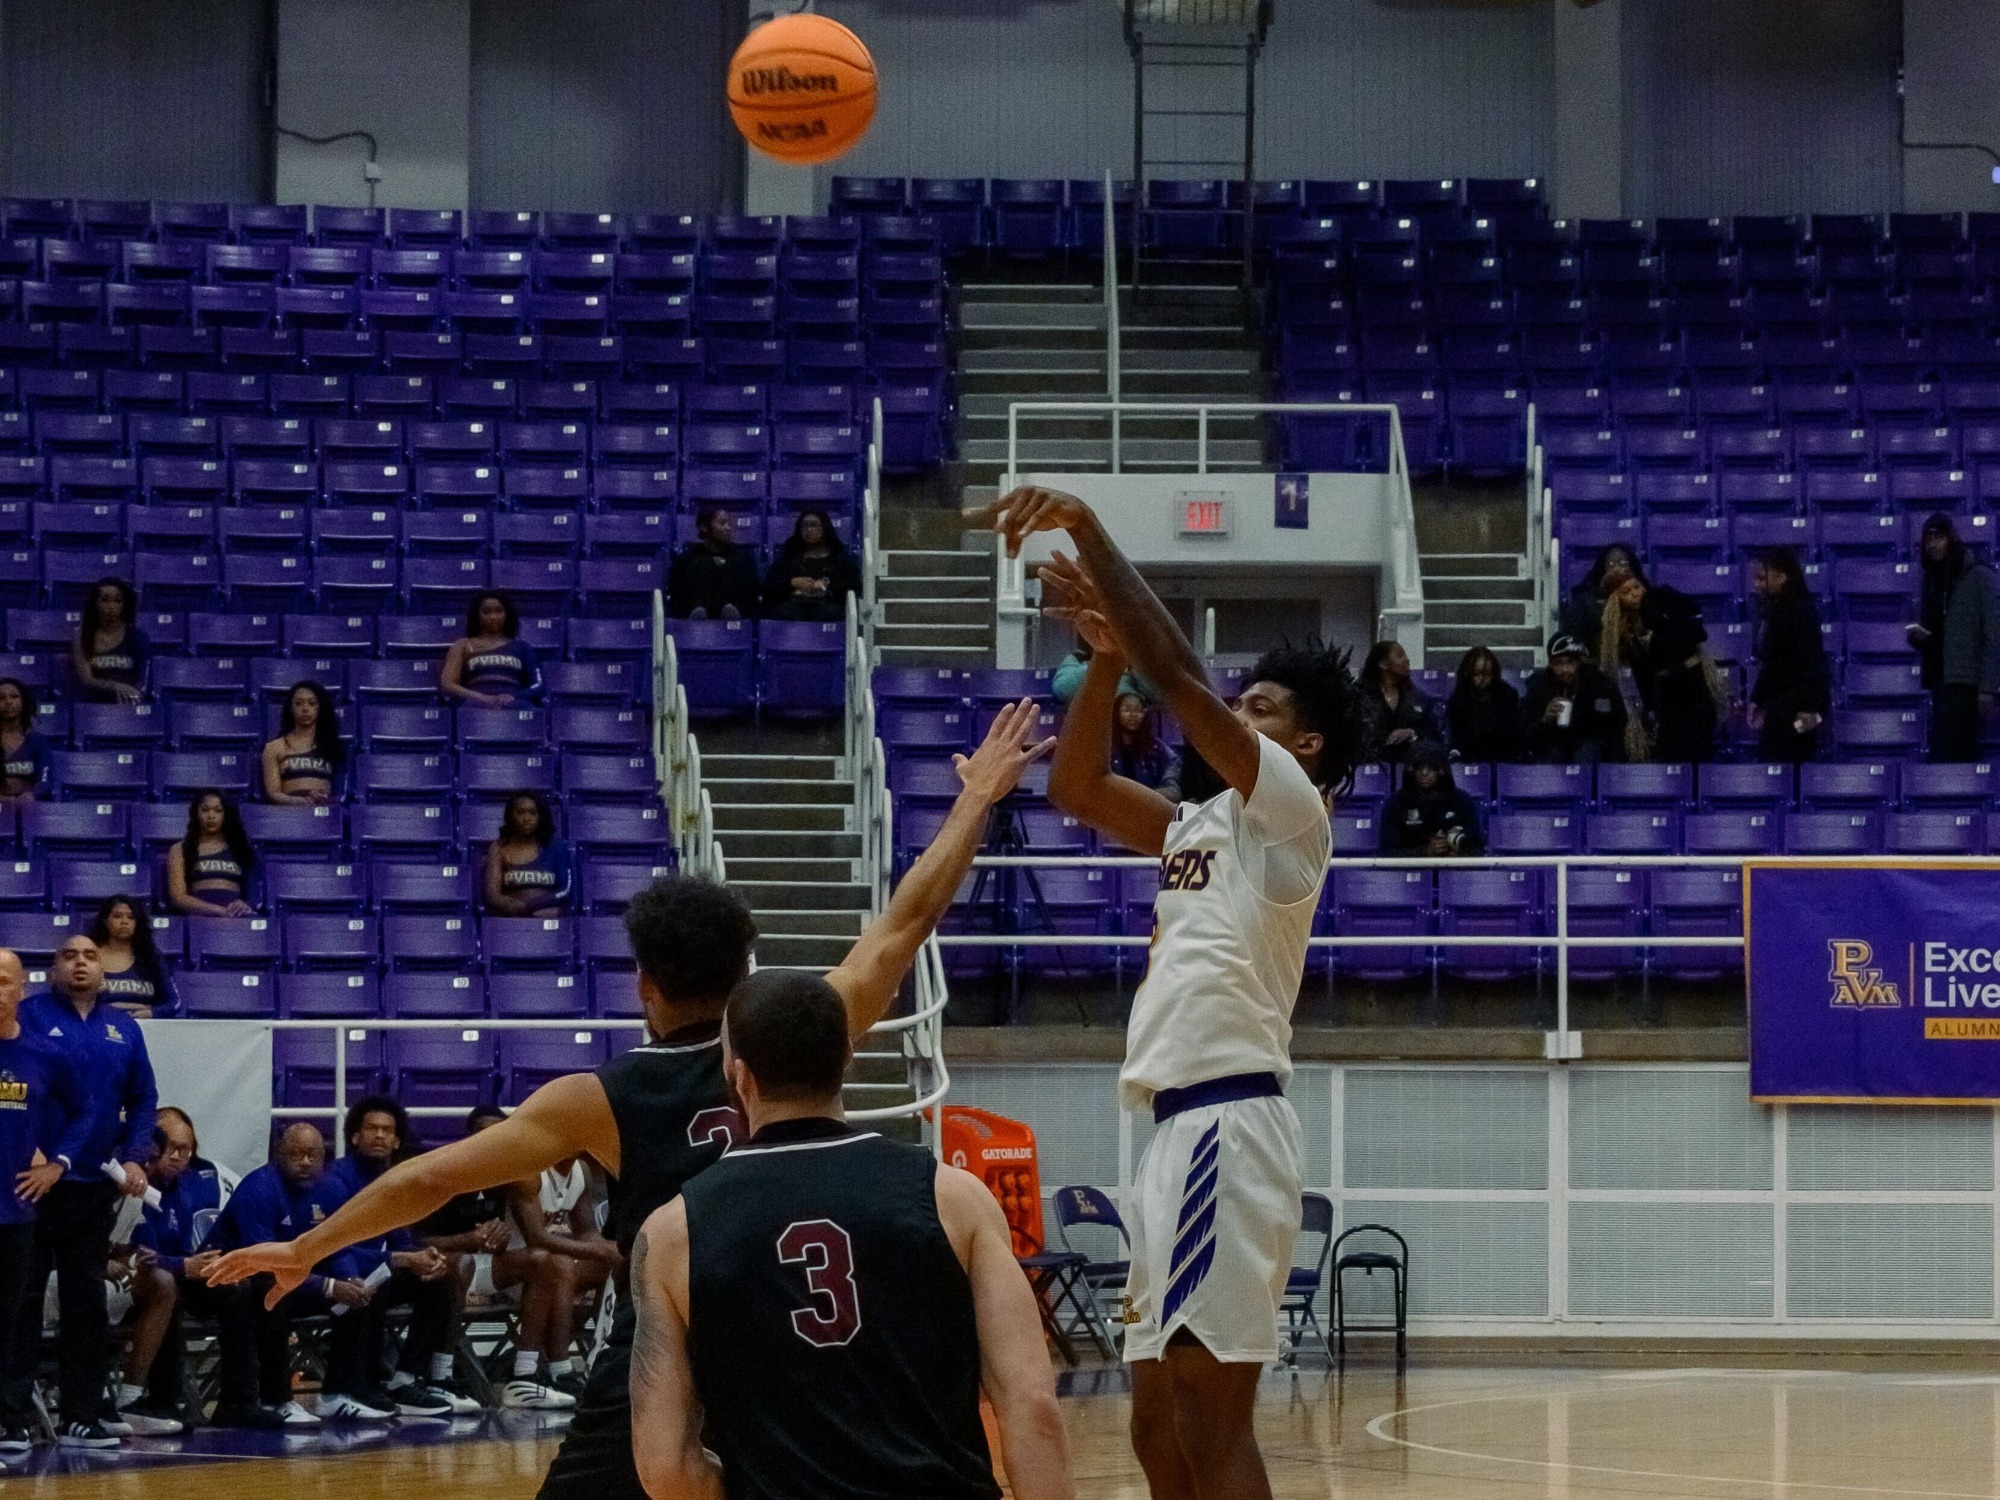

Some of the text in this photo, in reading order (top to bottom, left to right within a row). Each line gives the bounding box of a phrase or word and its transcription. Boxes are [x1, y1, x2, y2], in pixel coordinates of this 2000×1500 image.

[742, 66, 838, 96] Wilson
[1187, 501, 1223, 530] EXIT
[1924, 976, 2000, 1008] Live
[981, 1147, 1033, 1161] GATORADE
[776, 1218, 863, 1348] 3
